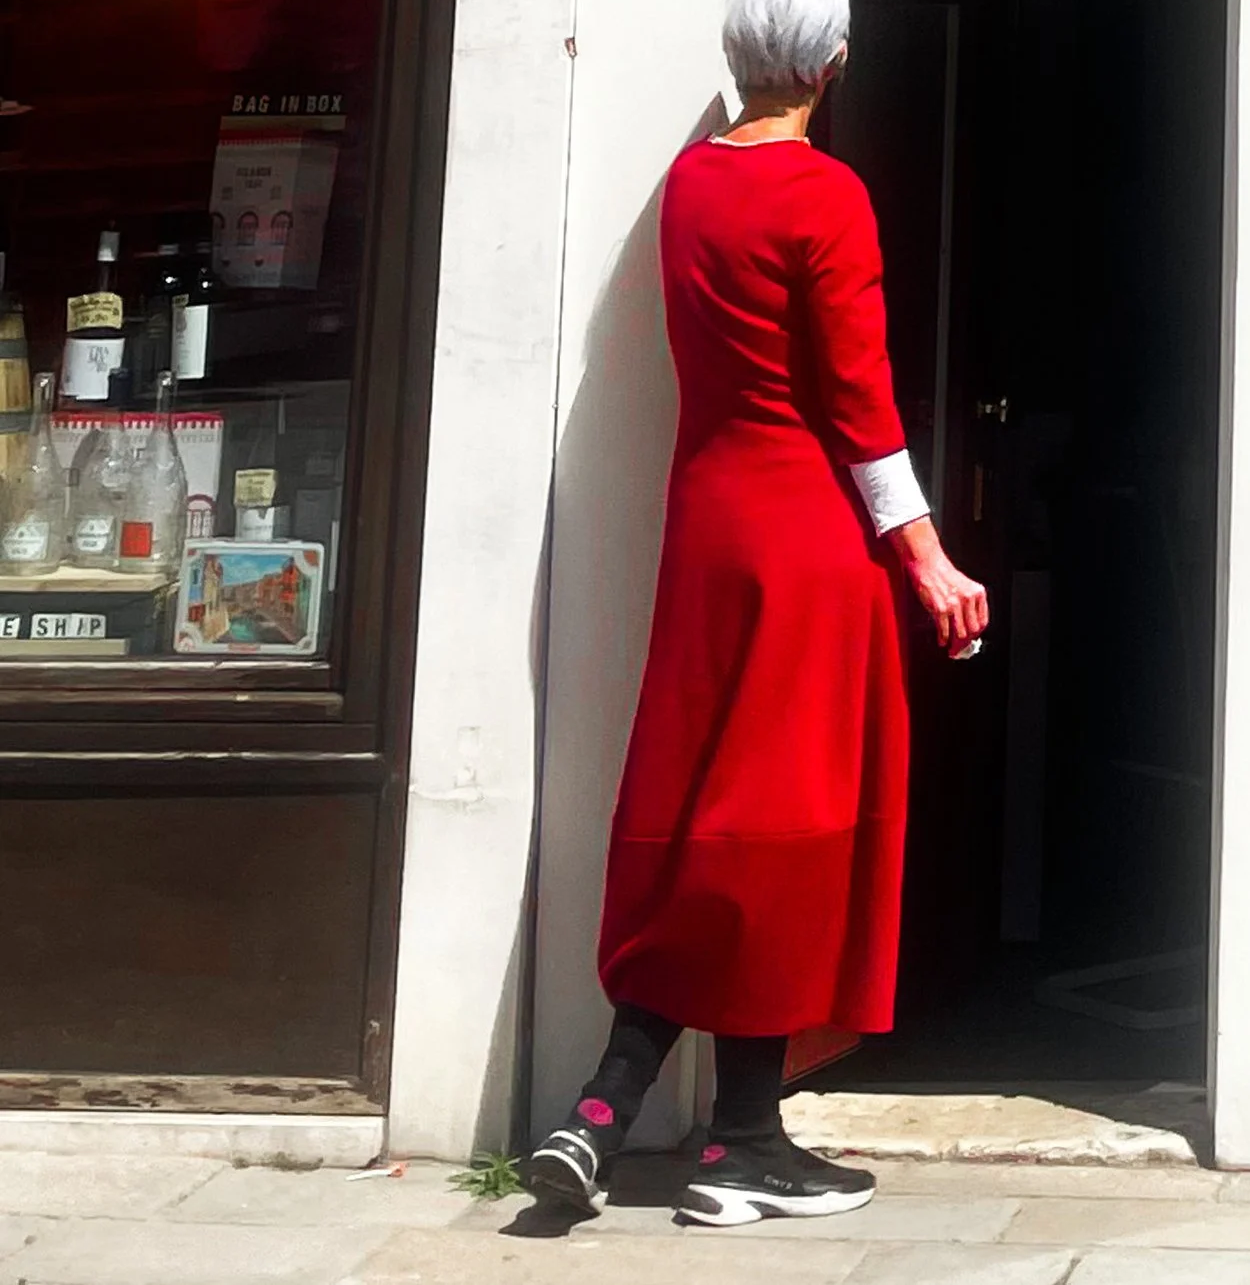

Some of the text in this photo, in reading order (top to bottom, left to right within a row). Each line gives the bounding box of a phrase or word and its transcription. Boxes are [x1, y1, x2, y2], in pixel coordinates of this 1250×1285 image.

[232, 94, 342, 113] BAG IN BOX
[3, 617, 101, 636] E SHIP
